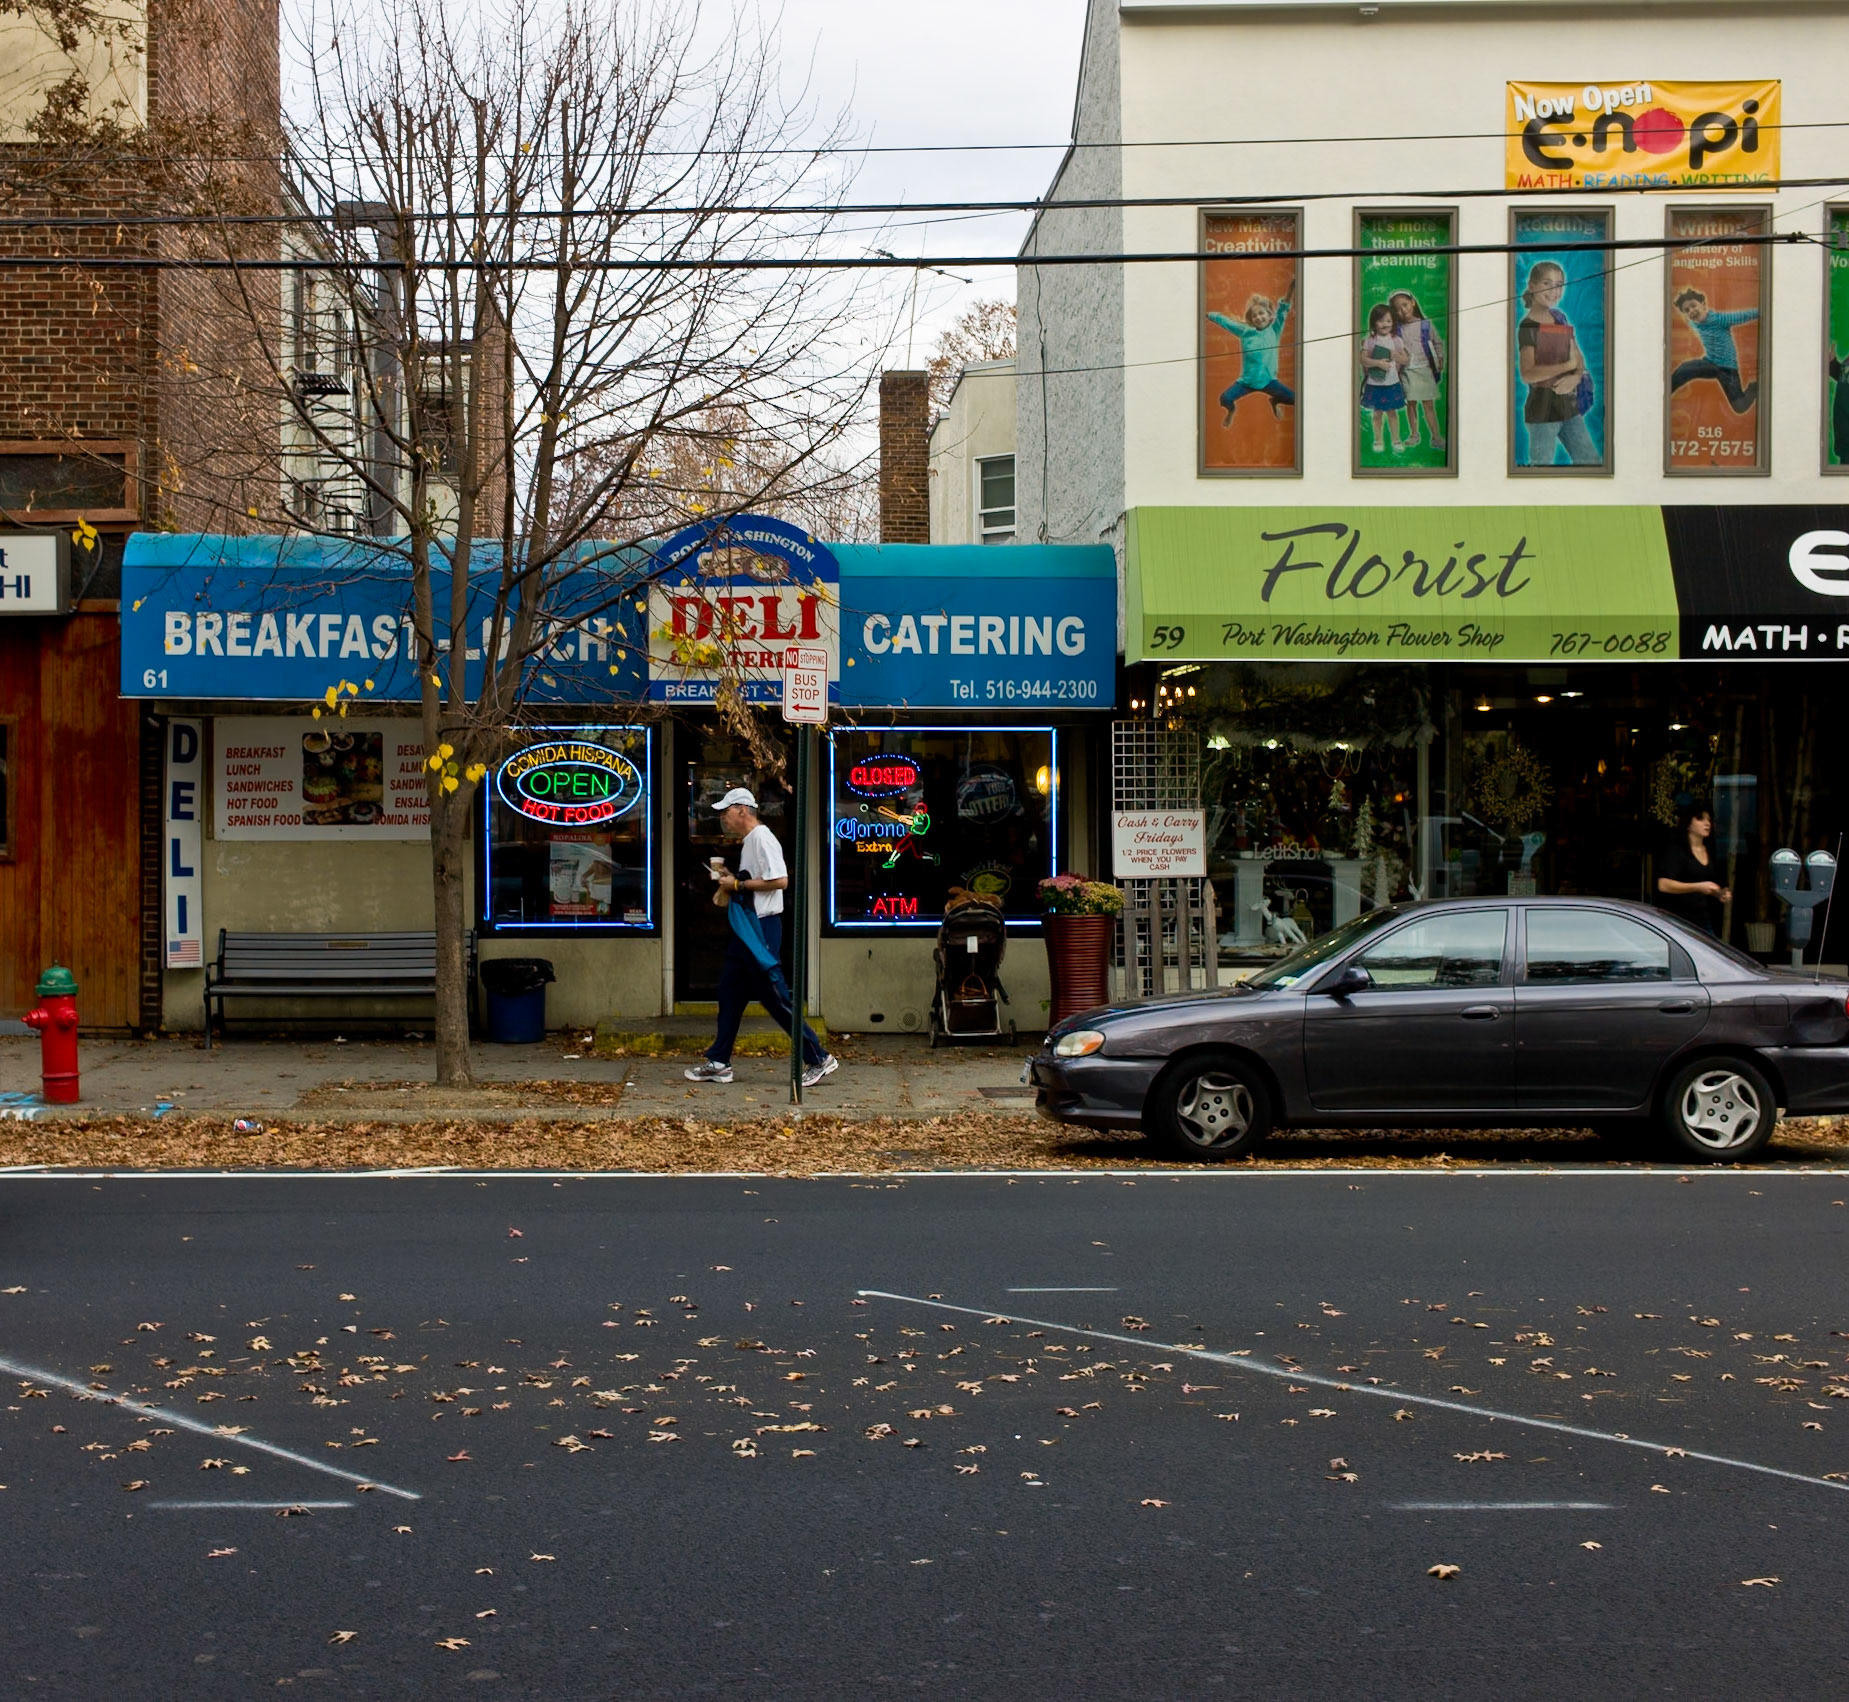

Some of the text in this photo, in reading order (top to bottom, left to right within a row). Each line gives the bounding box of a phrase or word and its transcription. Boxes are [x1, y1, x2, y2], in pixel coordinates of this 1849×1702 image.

[1514, 84, 1652, 121] Now Open
[1517, 172, 1770, 188] MATH READING WRITING
[1238, 221, 1277, 233] Math
[1372, 221, 1437, 233] It's more
[1517, 219, 1597, 235] Reading
[1678, 220, 1749, 237] Writing
[1205, 237, 1292, 254] Creativity
[1371, 236, 1405, 249] than
[1732, 244, 1743, 254] of
[1372, 254, 1437, 269] Learning
[1726, 256, 1759, 268] Skills
[1698, 427, 1722, 438] 516
[1261, 522, 1536, 602] Florist
[669, 595, 821, 641] DELI
[863, 614, 1086, 656] CATERING
[1151, 622, 1672, 655] 59 Port Washington Flower Shop 767-0088
[1702, 624, 1808, 651] MATH
[786, 651, 825, 666] NO STOPPING
[143, 668, 168, 688] 61
[794, 673, 817, 686] BUS
[791, 688, 820, 701] STOP
[950, 680, 1097, 699] Tel. 516-944-2300
[226, 747, 286, 759] BREAKFAST
[226, 764, 261, 776] LUNCH
[506, 745, 633, 781] COMIDA HISPANA
[530, 771, 609, 797] OPEN
[851, 766, 916, 786] CLOSED
[226, 780, 294, 792] SANDWICHES
[227, 797, 278, 810] HOT FOOD
[522, 798, 615, 823] HOT FOOD
[227, 814, 301, 827] SPANISH FOOD
[1117, 815, 1200, 831] Cash & Carry
[171, 724, 198, 934] DELI
[836, 817, 906, 842] Corona
[855, 841, 893, 853] Extra
[1133, 831, 1184, 847] Fridays
[1136, 848, 1158, 856] PRICE
[1161, 848, 1197, 856] FLOWERS
[1149, 863, 1170, 871] CASH
[873, 897, 917, 914] ATM
